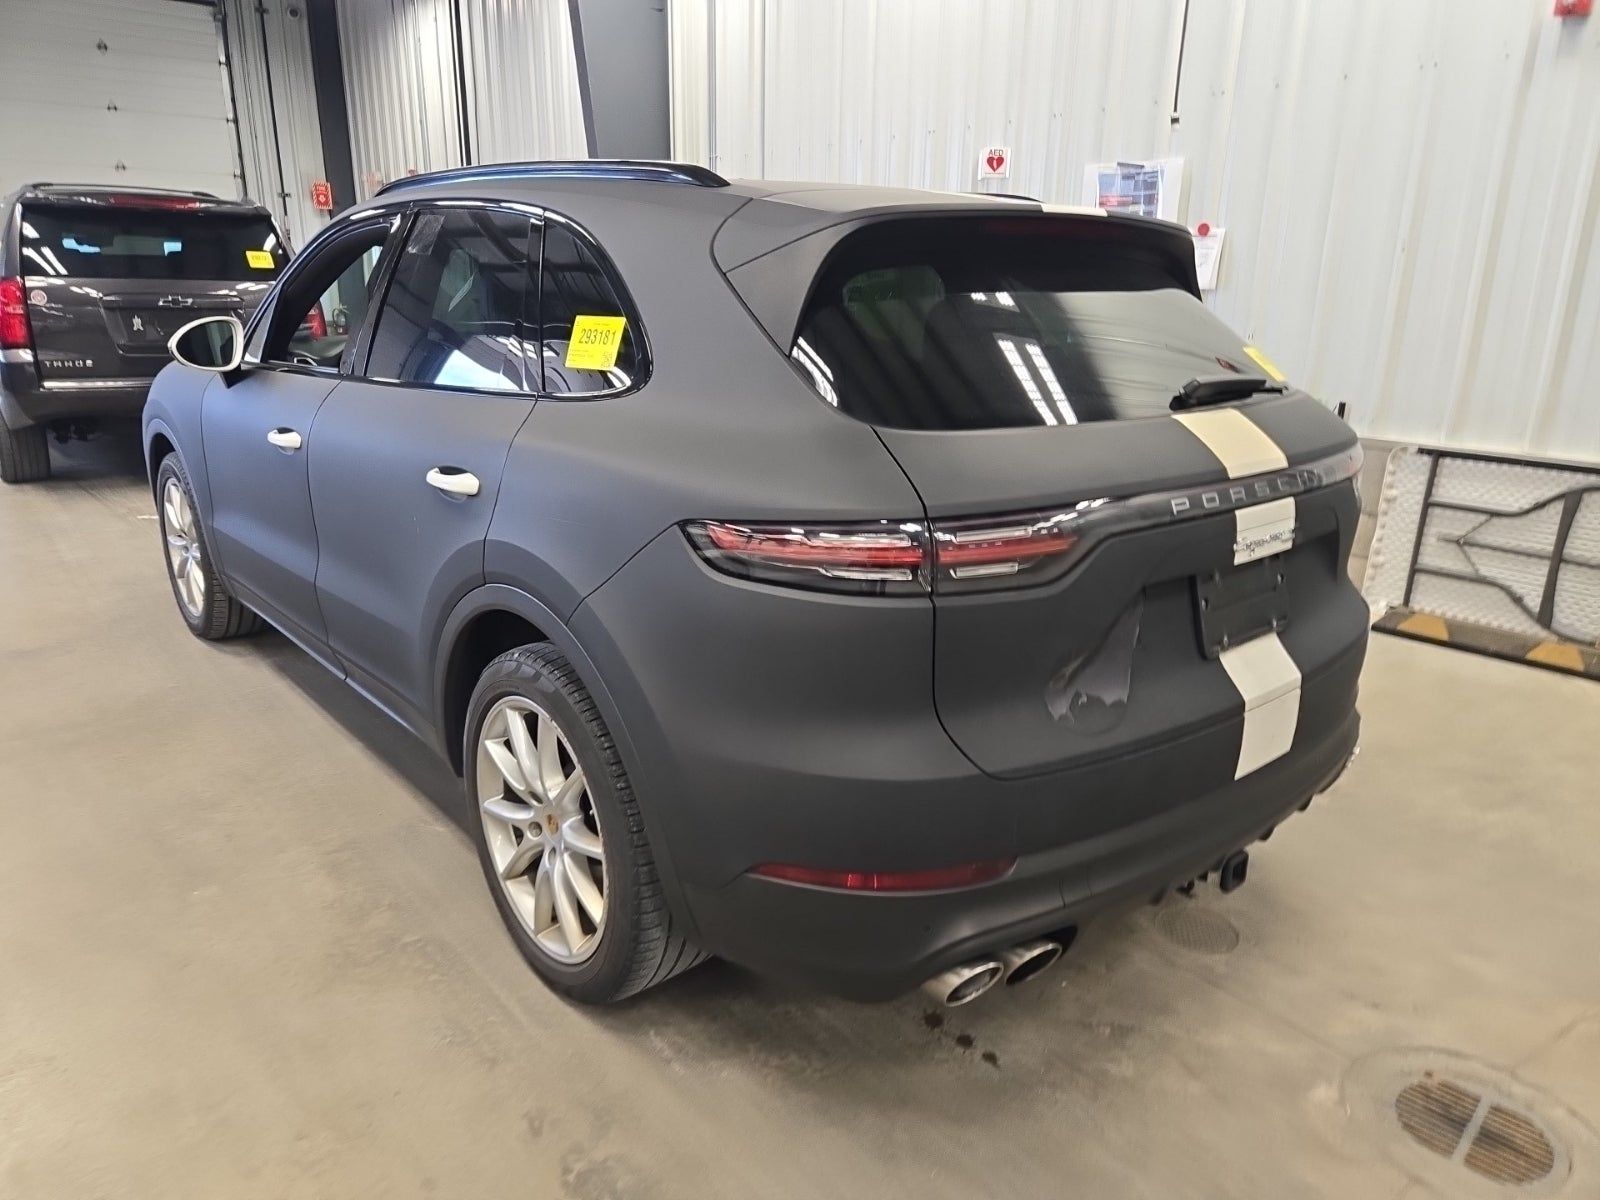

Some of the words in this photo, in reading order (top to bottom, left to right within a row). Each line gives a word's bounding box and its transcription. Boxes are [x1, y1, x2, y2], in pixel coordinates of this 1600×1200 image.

[989, 148, 1004, 156] AED
[578, 328, 616, 345] 293181
[44, 359, 93, 367] TAHOE
